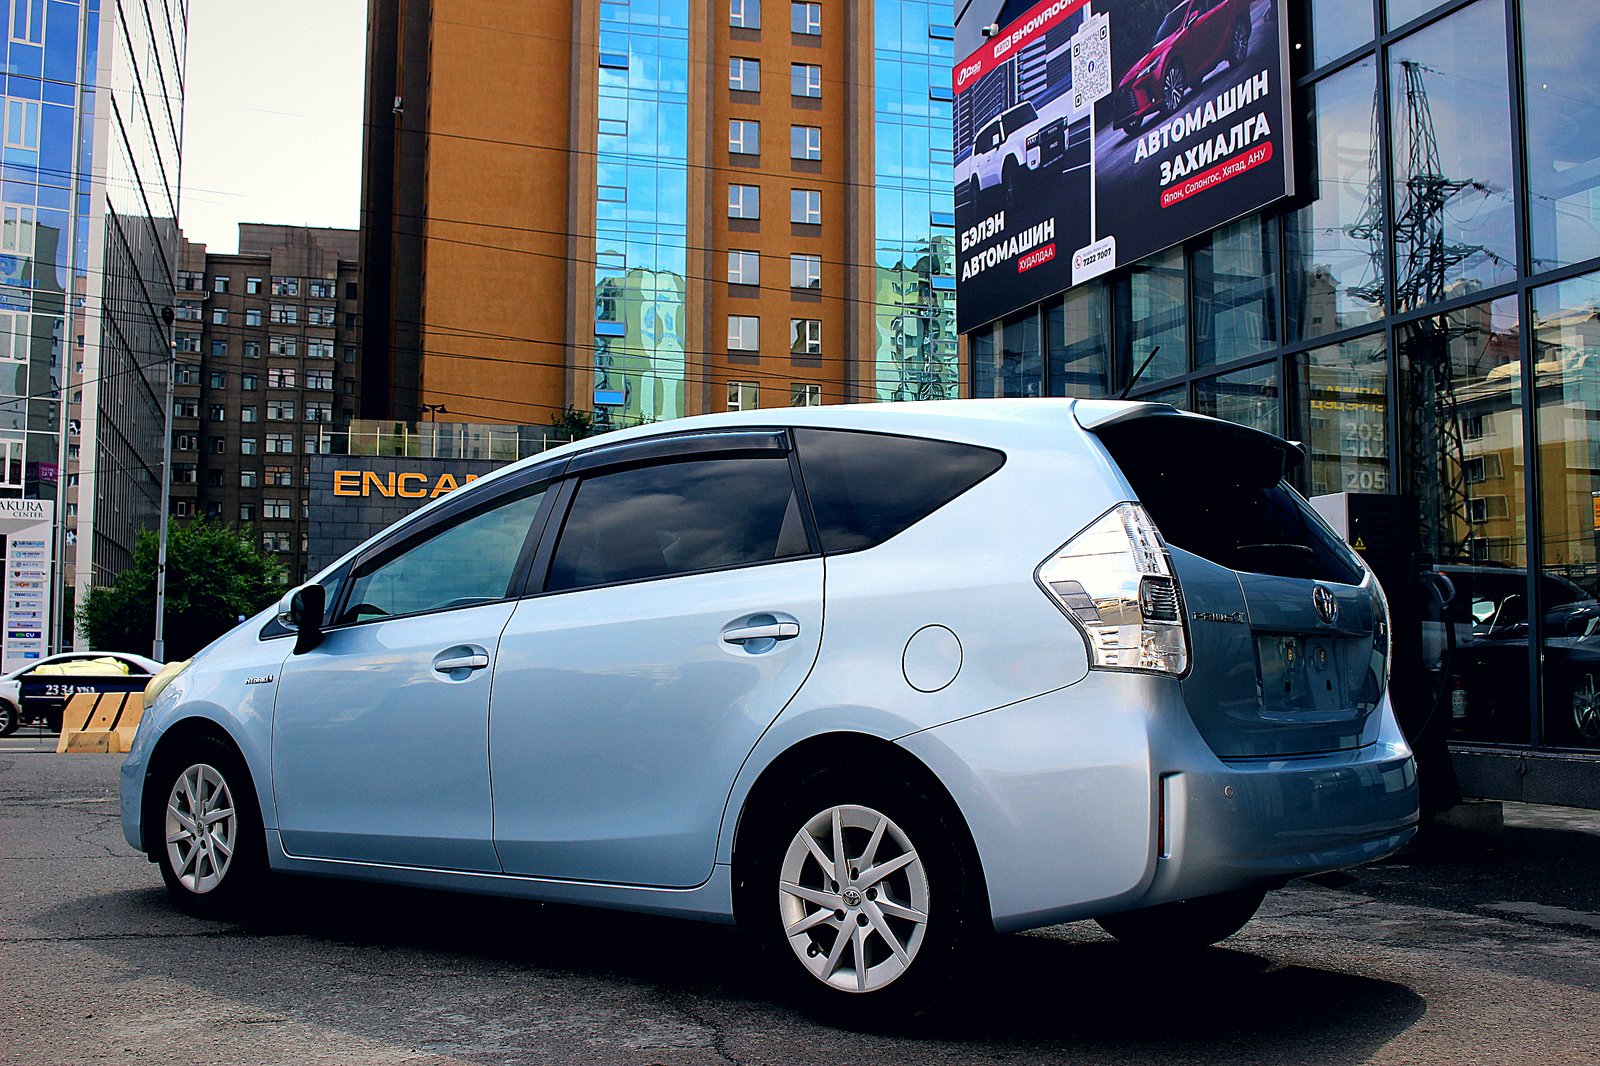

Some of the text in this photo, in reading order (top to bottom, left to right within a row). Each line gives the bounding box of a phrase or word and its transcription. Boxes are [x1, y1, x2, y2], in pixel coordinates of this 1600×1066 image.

[1134, 69, 1269, 163] АВТОМАШИН
[1159, 112, 1271, 186] ЗАХИАЛГА
[1163, 148, 1266, 205] Япон, Солонгос, Хятад, АНУ
[961, 210, 1005, 252] БЭЛЭН
[961, 217, 1055, 283] АВТОМАШИН
[1019, 247, 1054, 271] ХУДАЛДАА
[1083, 254, 1097, 267] 7222
[1097, 247, 1112, 261] 7007
[1346, 422, 1384, 441] 203
[1346, 469, 1386, 490] 205
[45, 684, 59, 695] 23
